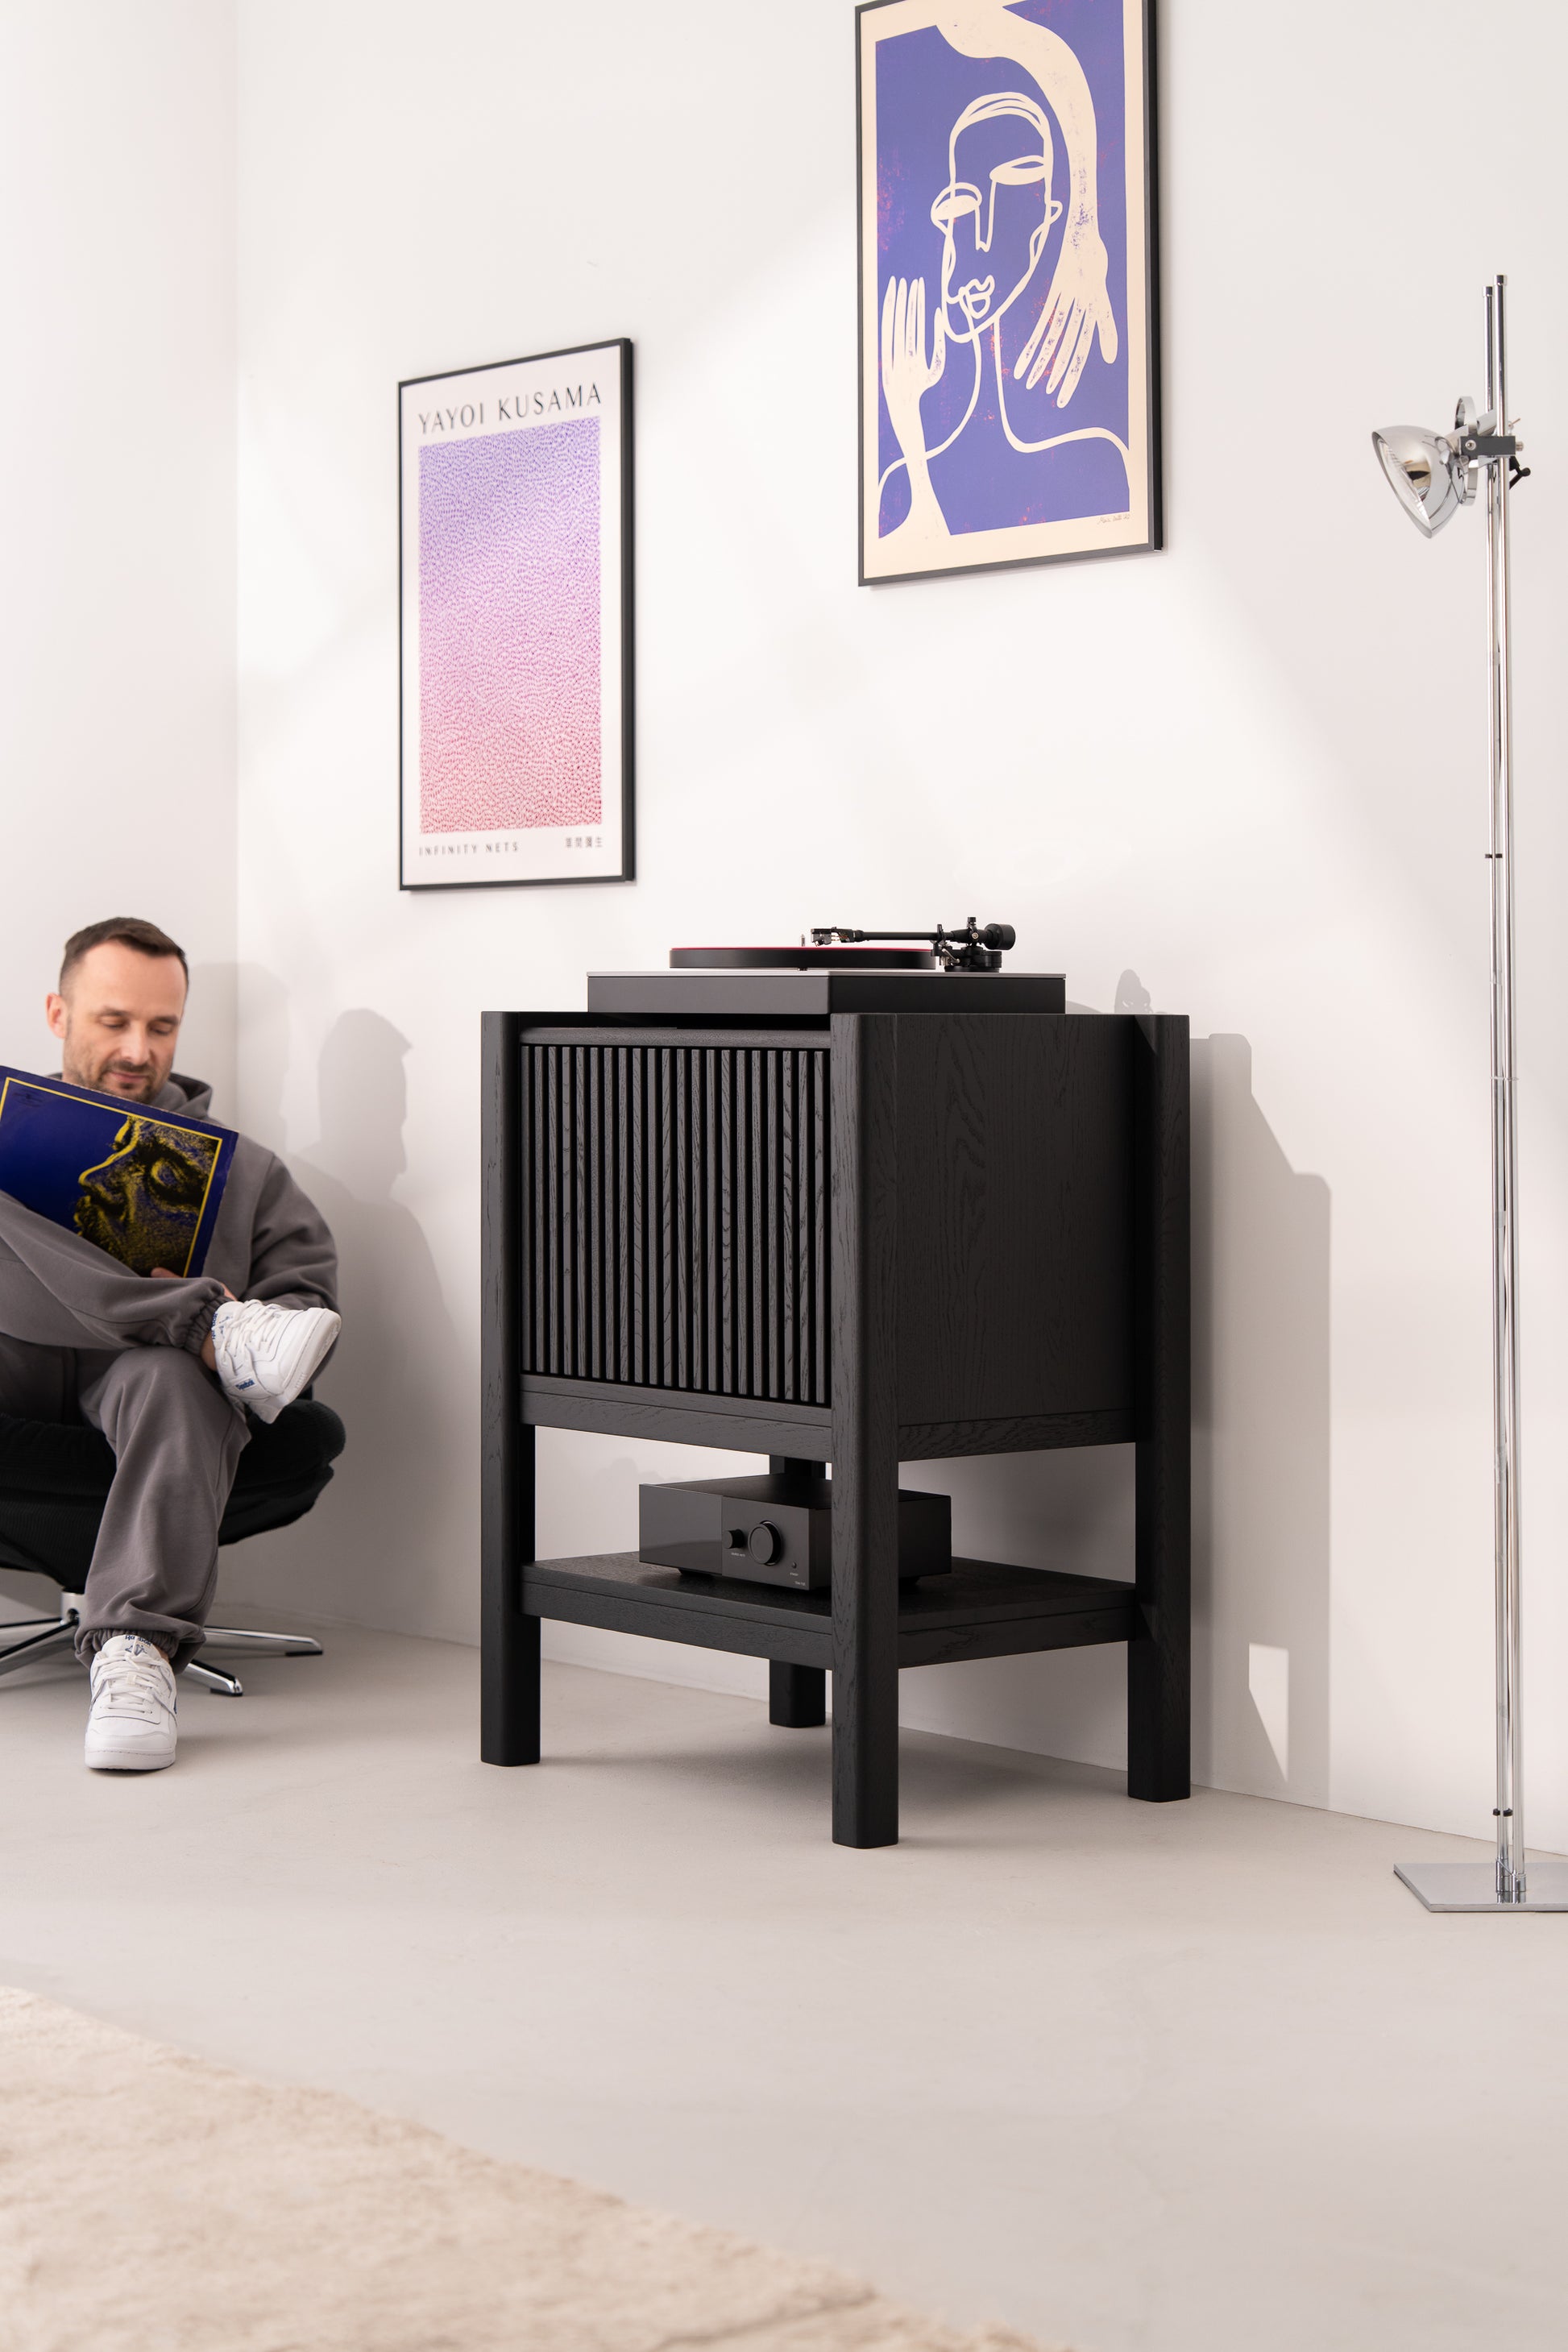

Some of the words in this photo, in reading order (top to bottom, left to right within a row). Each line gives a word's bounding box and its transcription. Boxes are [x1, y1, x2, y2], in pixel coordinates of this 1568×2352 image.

[418, 401, 484, 435] YAYOI
[498, 382, 602, 421] KUSAMA
[419, 844, 477, 857] INFINITY
[485, 841, 519, 853] NETS
